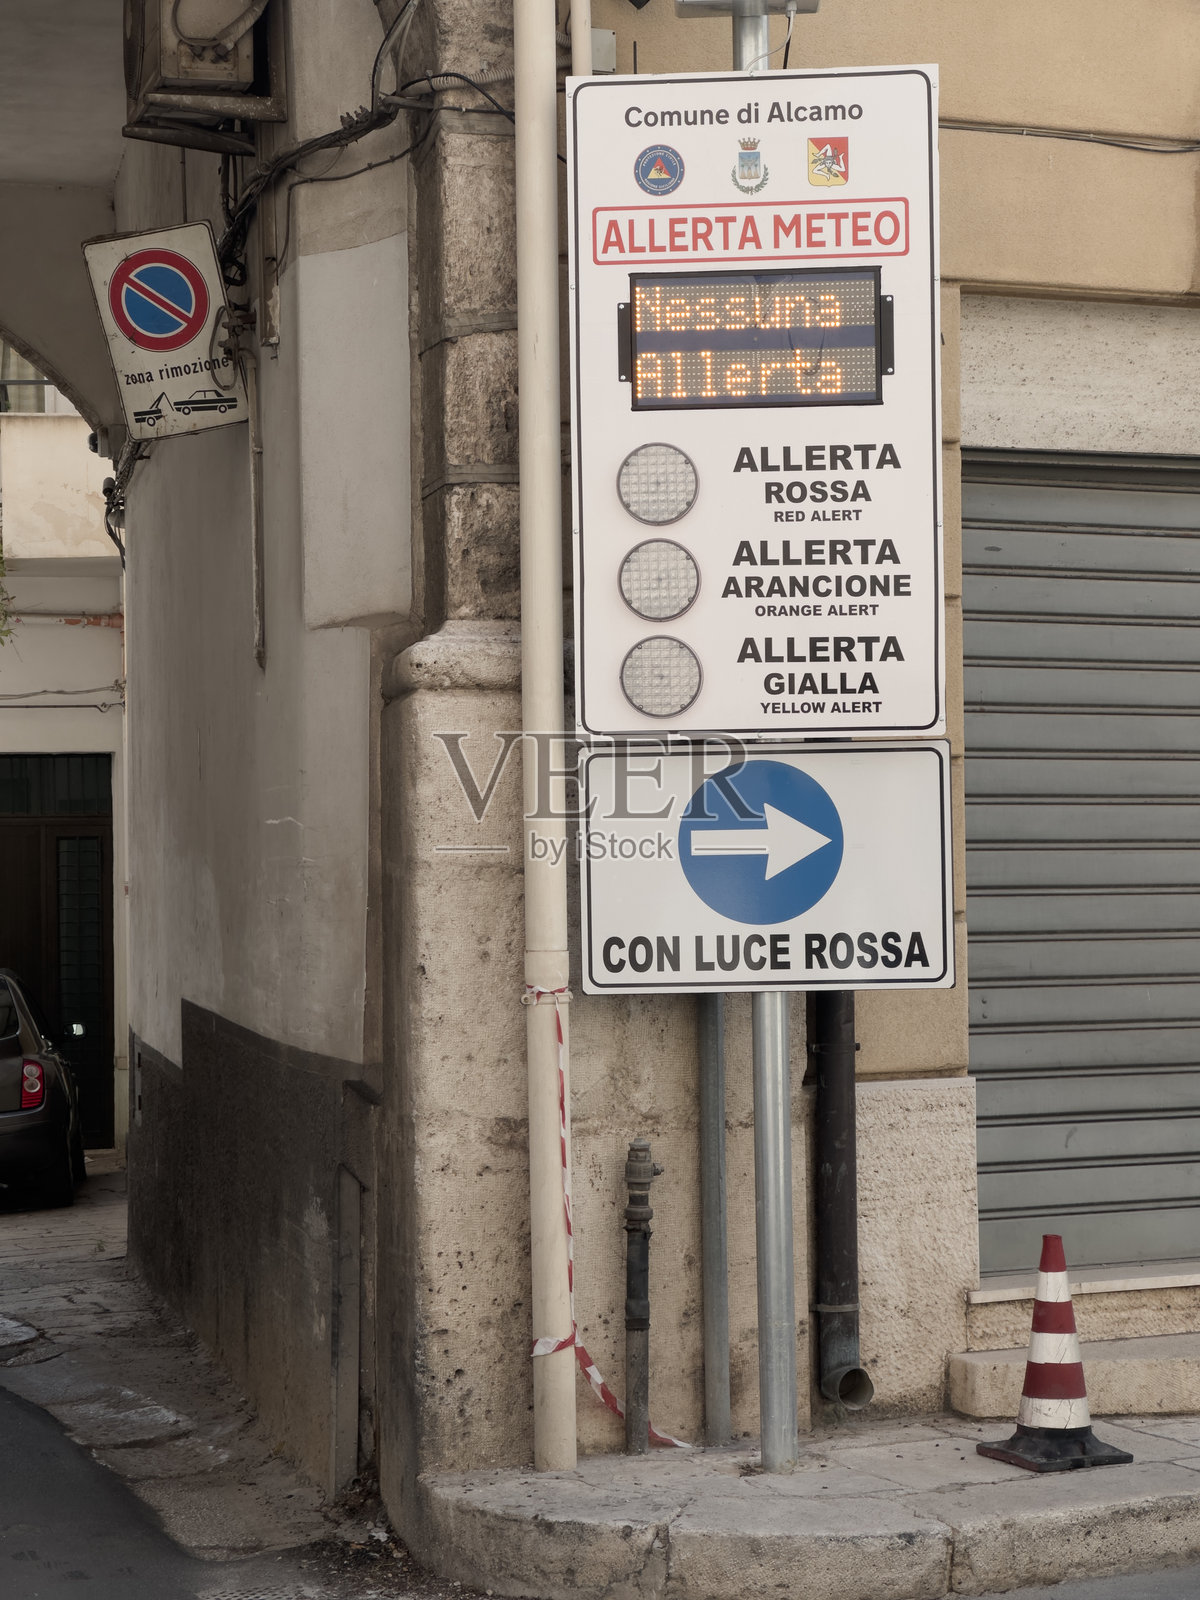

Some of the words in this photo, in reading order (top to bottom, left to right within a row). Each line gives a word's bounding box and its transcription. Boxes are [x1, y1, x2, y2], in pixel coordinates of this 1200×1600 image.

[624, 106, 729, 128] Comune
[736, 103, 760, 124] di
[767, 101, 864, 123] Alcamo
[601, 215, 763, 255] ALLERTA
[773, 210, 901, 249] METEO
[635, 286, 841, 332] Nessuna
[124, 371, 154, 385] zona
[158, 356, 230, 380] rimozione
[636, 349, 842, 399] Allerta
[733, 443, 901, 473] ALLERTA
[764, 480, 872, 504] ROSSA
[773, 510, 805, 523] RED
[810, 509, 862, 522] ALERT
[732, 538, 901, 566] ALLERTA
[721, 574, 912, 598] ARANCIONE
[754, 604, 823, 617] ORANGE
[827, 604, 879, 616] ALERT
[737, 636, 905, 663] ALLERTA
[763, 672, 880, 695] GIALLA
[760, 702, 826, 714] YELLOW
[830, 701, 882, 713] ALERT
[603, 935, 681, 973] CON
[695, 933, 791, 971] LUCE
[804, 931, 930, 969] ROSSA
